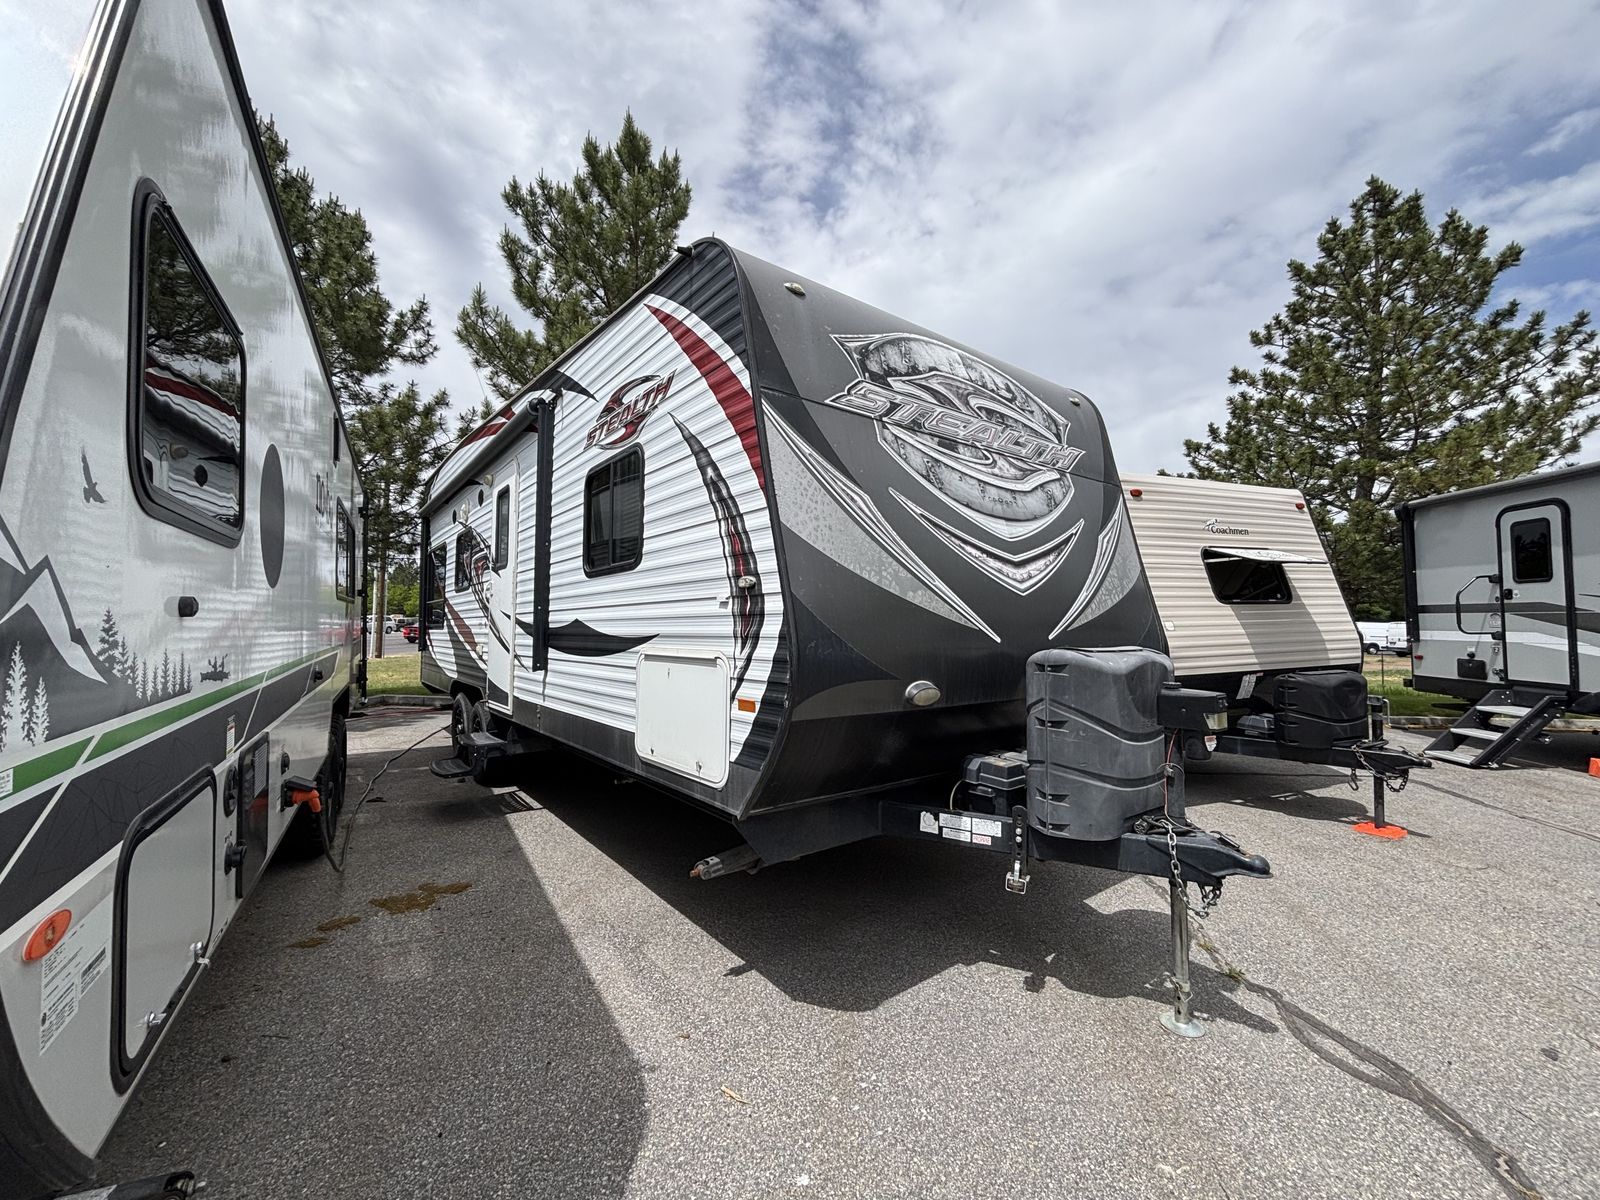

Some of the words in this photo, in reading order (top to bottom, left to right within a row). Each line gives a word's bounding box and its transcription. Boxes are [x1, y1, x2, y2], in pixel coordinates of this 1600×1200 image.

[584, 369, 677, 451] STEALTH
[826, 380, 1085, 471] STEALTH
[1211, 526, 1250, 536] Coachmen
